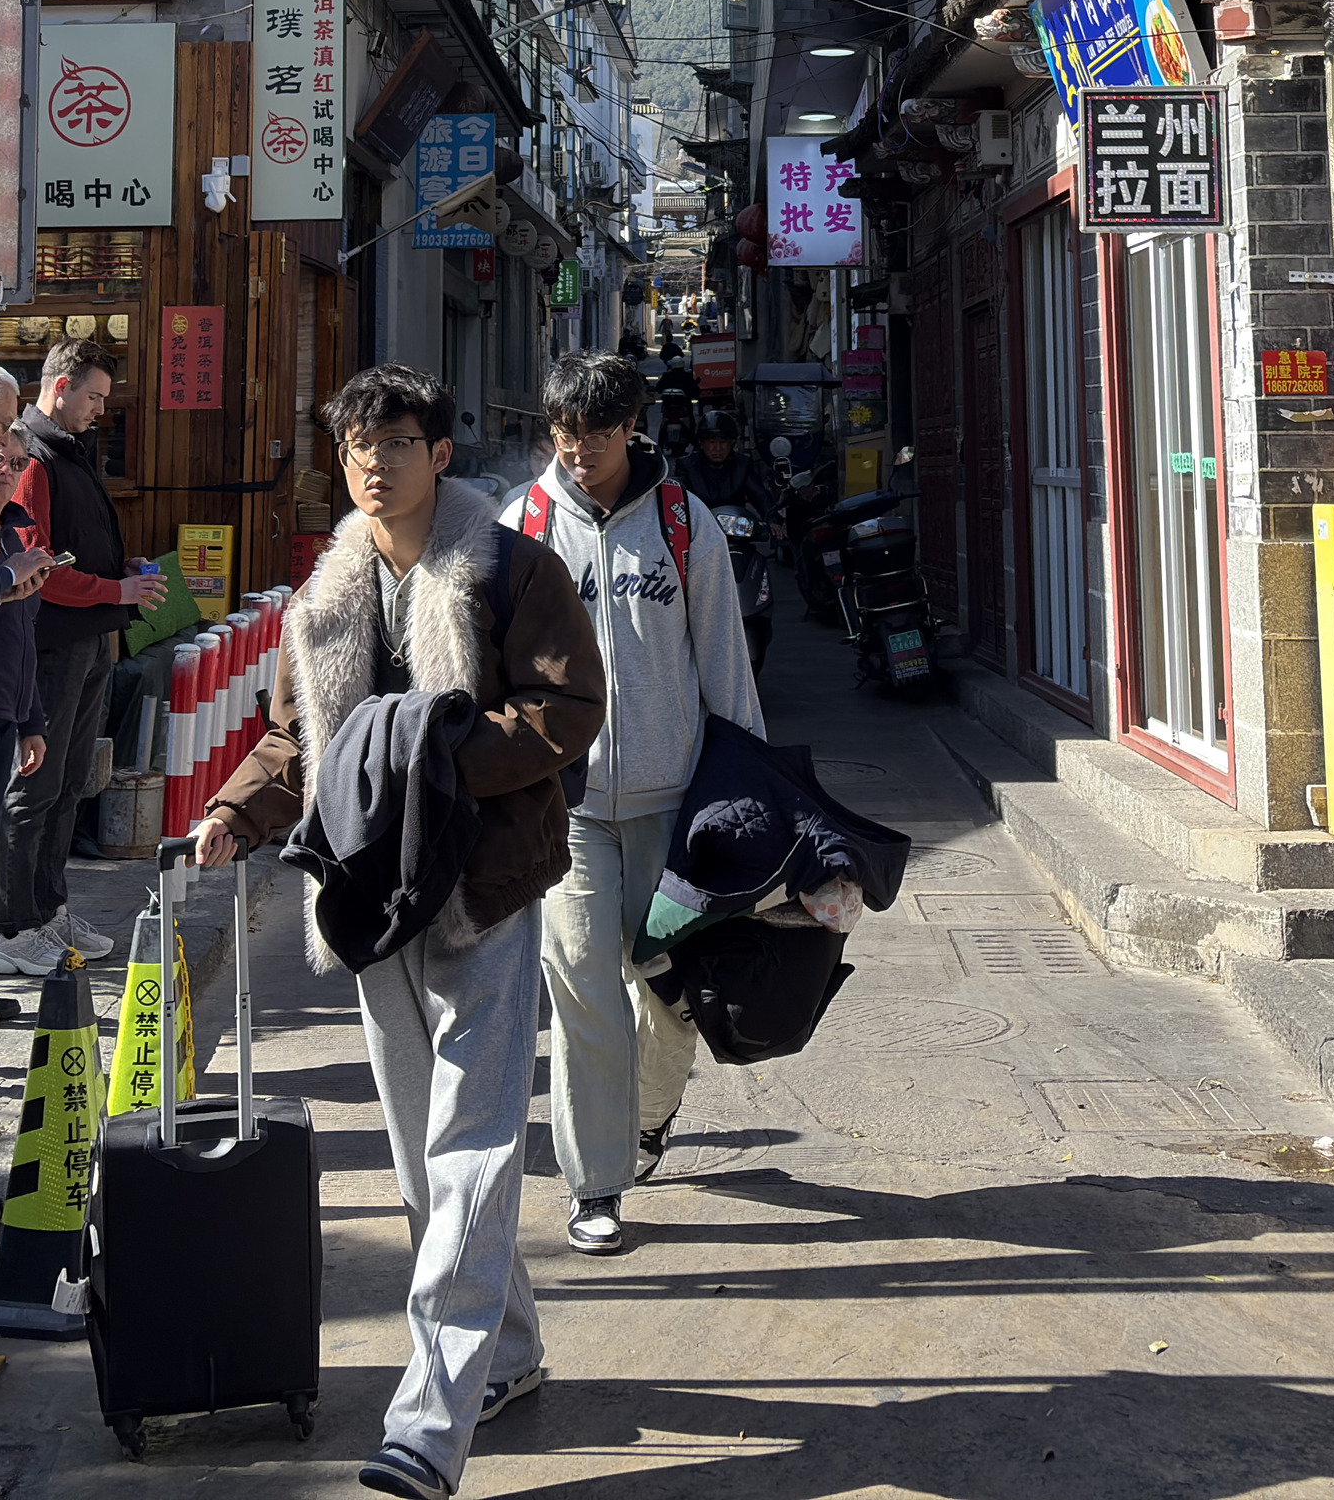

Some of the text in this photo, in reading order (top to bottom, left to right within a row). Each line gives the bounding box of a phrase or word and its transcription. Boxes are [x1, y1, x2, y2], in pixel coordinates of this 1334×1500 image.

[57, 81, 125, 133] 茶
[1096, 103, 1208, 157] 兰州
[779, 160, 855, 192] 特产
[1096, 160, 1210, 216] 拉面
[44, 179, 152, 210] 喝中心
[779, 202, 856, 234] 批发
[416, 233, 491, 247] 19038727602
[1265, 365, 1324, 379] 别墅 院子
[1278, 350, 1308, 365] 急售
[1266, 379, 1325, 393] 18687262668
[62, 1082, 90, 1212] 禁止停车
